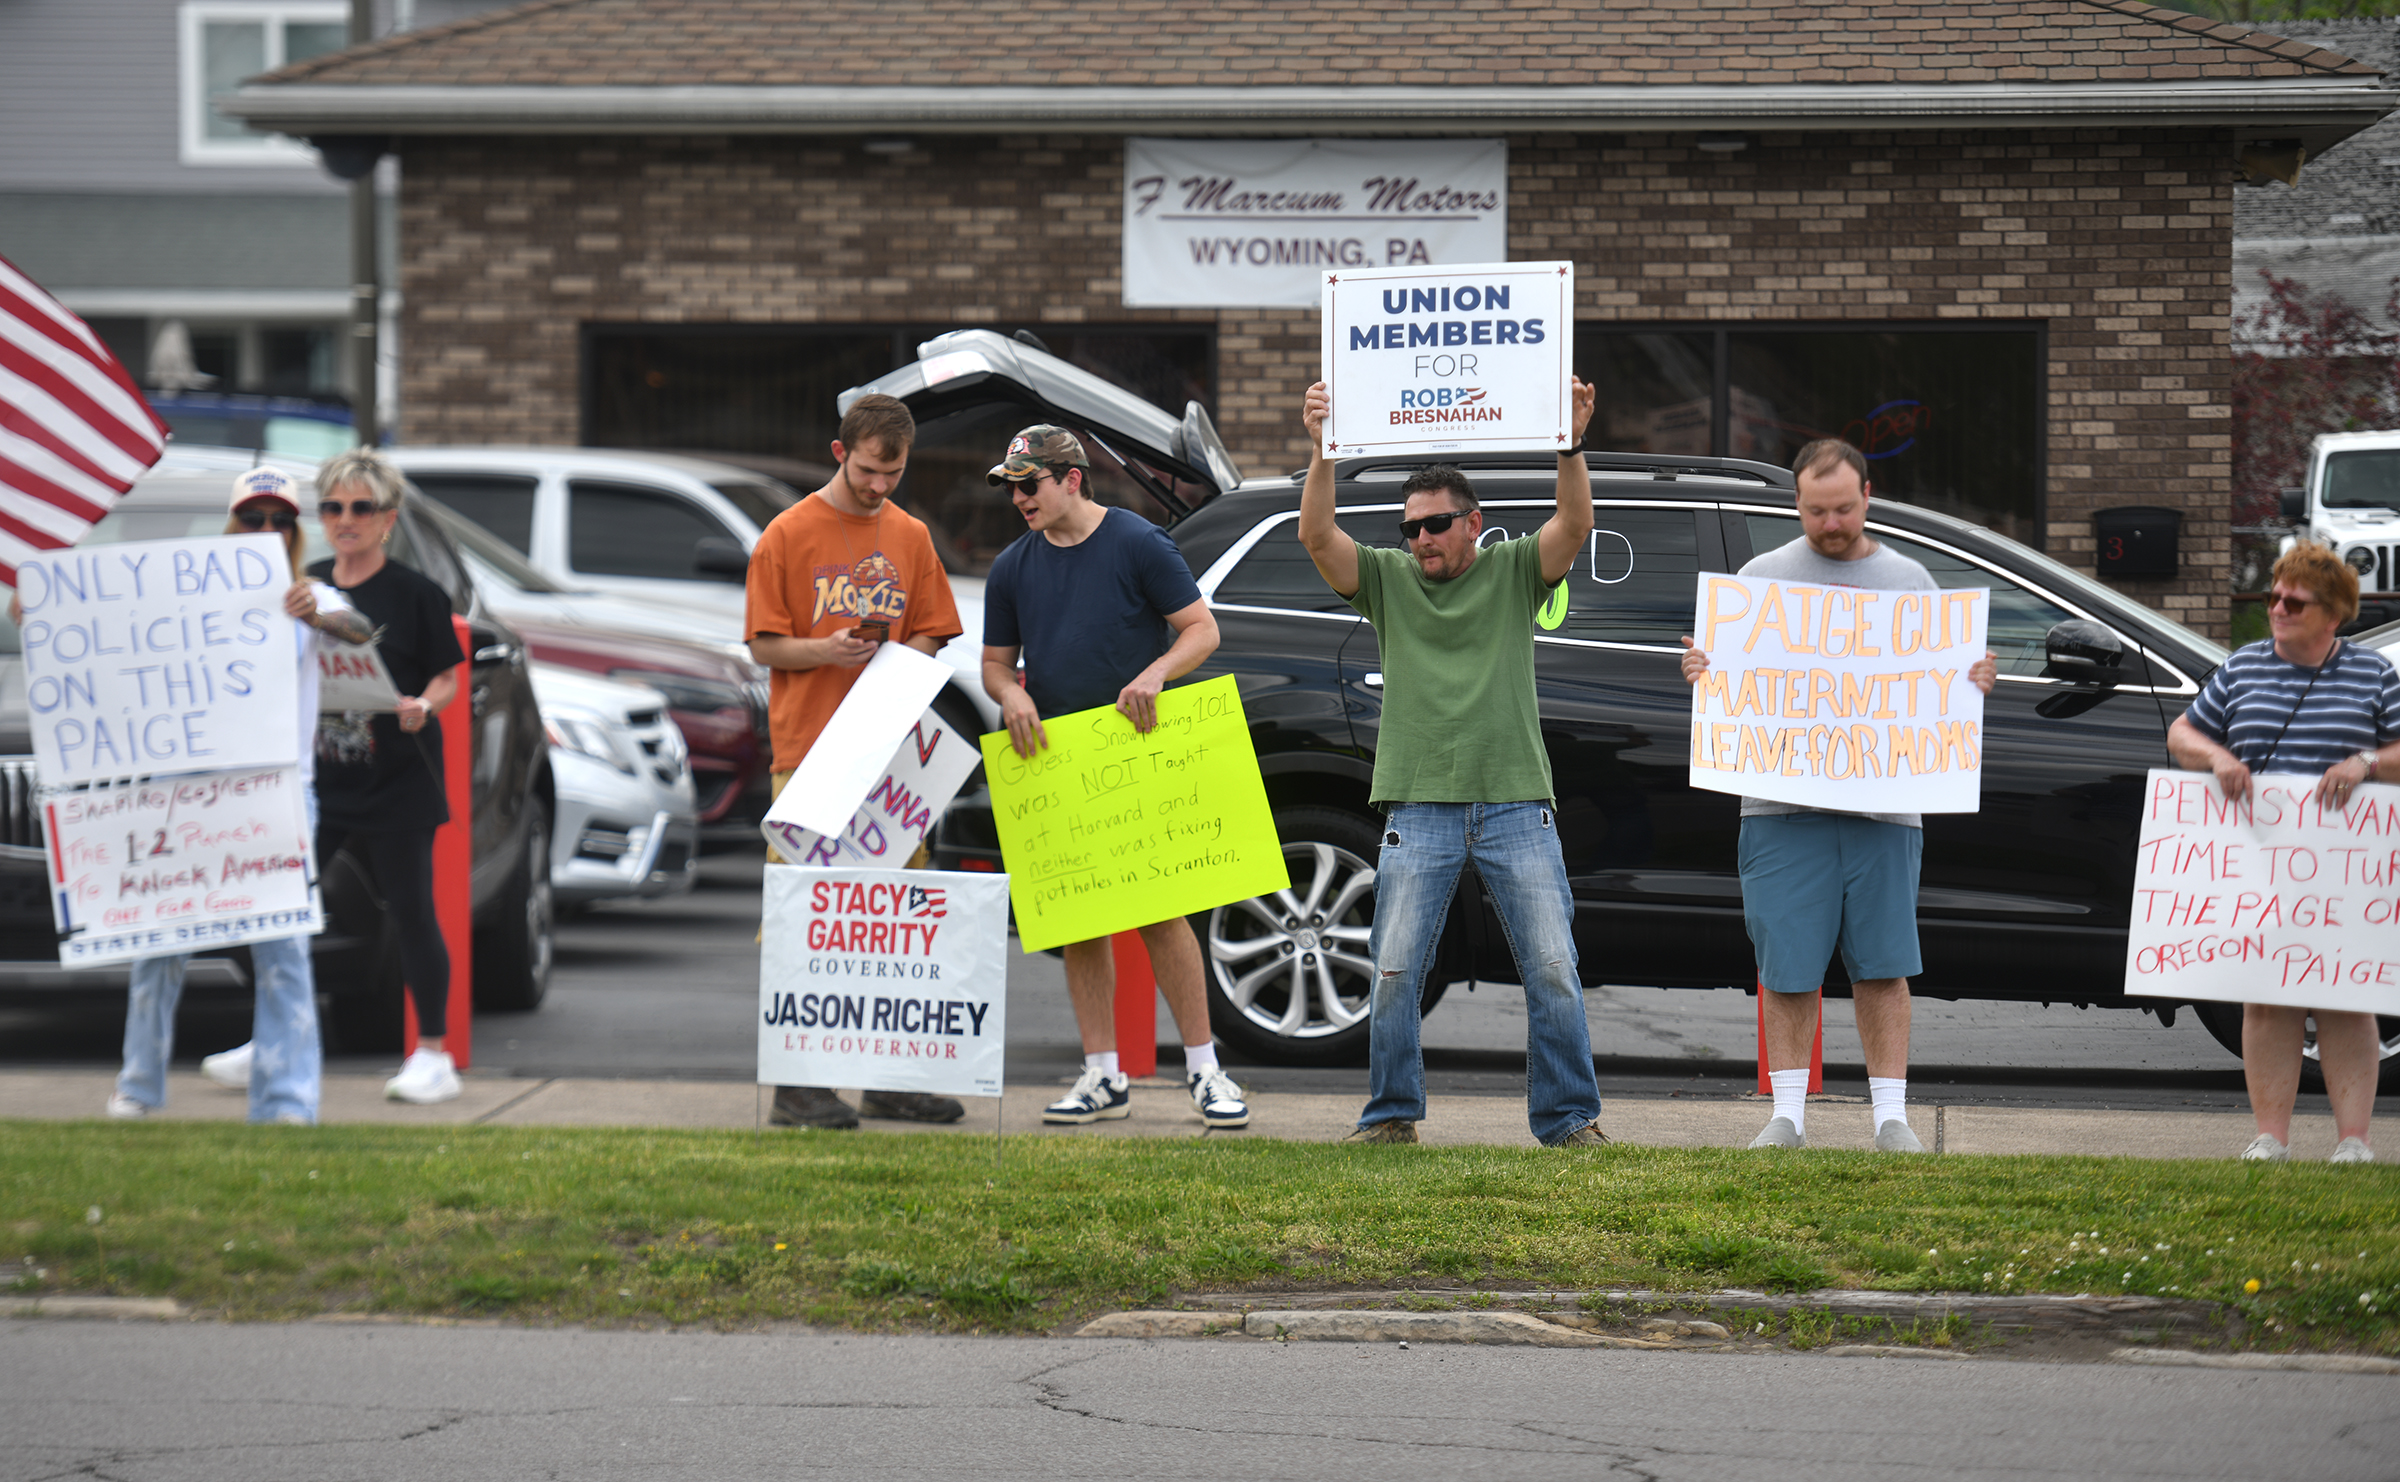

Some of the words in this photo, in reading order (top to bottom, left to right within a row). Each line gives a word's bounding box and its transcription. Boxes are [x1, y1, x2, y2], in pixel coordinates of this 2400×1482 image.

[1179, 175, 1346, 212] Marcum
[1362, 175, 1501, 212] Motors
[1189, 237, 1374, 268] WYOMING,
[1385, 237, 1431, 266] PA
[1382, 285, 1510, 315] UNION
[1350, 318, 1545, 351] MEMBERS
[1415, 354, 1478, 378] FOR
[1389, 407, 1502, 425] BRESNAHAN
[1401, 387, 1453, 409] ROB
[2105, 536, 2124, 560] 3
[16, 552, 149, 614] ONLY
[173, 547, 272, 596] BAD
[813, 564, 850, 576] DRINK
[1704, 577, 1880, 659] PAIGE
[1892, 591, 1981, 656] CUT
[29, 668, 96, 714] ON
[1697, 667, 1958, 720] MATERNITY
[997, 743, 1073, 786] Guess
[1193, 692, 1235, 723] 101
[1693, 721, 1807, 778] LEAVE
[1887, 720, 1981, 778] MOMS
[1008, 791, 1061, 821] was
[1081, 756, 1138, 796] NOT
[1148, 744, 1209, 773] Taught
[1024, 822, 1051, 853] at
[1068, 798, 1144, 844] Harvard
[1158, 781, 1199, 816] and
[1029, 851, 1093, 879] neither
[1109, 833, 1157, 858] was
[1164, 817, 1222, 842] fixing
[1120, 868, 1138, 884] in
[1148, 847, 1241, 880] Scranton.
[2260, 846, 2318, 886] TO
[810, 881, 907, 916] STACY
[2137, 889, 2222, 927] THE
[2231, 892, 2344, 929] PAGE
[70, 931, 163, 958] STATE
[176, 907, 317, 939] SENATOR
[807, 919, 938, 956] GARRITY
[809, 957, 941, 980] GOVERNOR
[2136, 933, 2264, 974] OREGON
[764, 992, 865, 1030] JASON
[871, 998, 989, 1036] RICHEY
[785, 1034, 813, 1051] LT.
[822, 1036, 957, 1060] GOVERNOR
